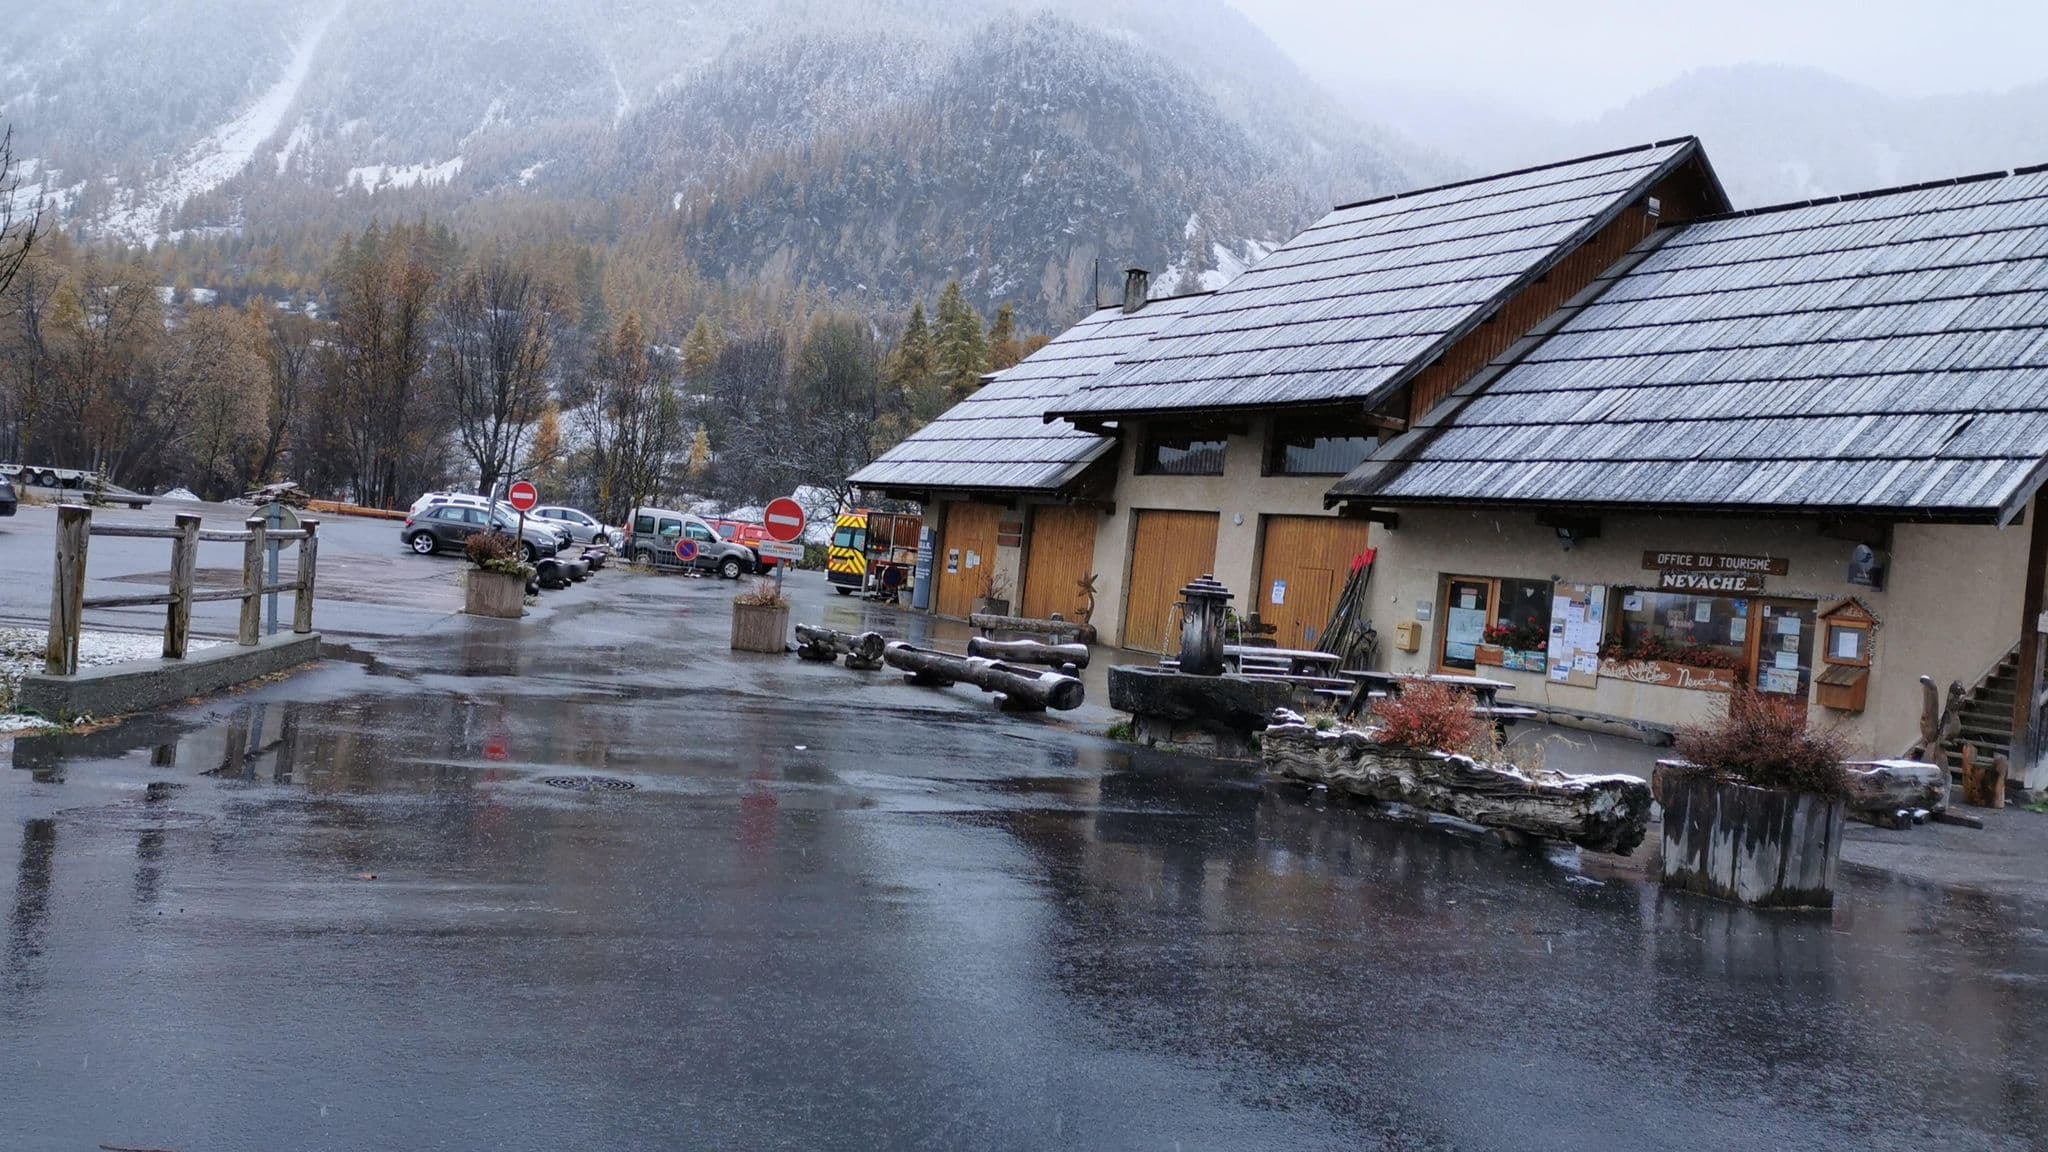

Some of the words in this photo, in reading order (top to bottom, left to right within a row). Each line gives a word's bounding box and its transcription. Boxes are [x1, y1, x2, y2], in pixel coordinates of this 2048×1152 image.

[1657, 553, 1693, 566] OFFICE
[1698, 555, 1713, 567] DU
[1720, 557, 1771, 571] TOURISME
[1662, 574, 1748, 591] NEVACHE
